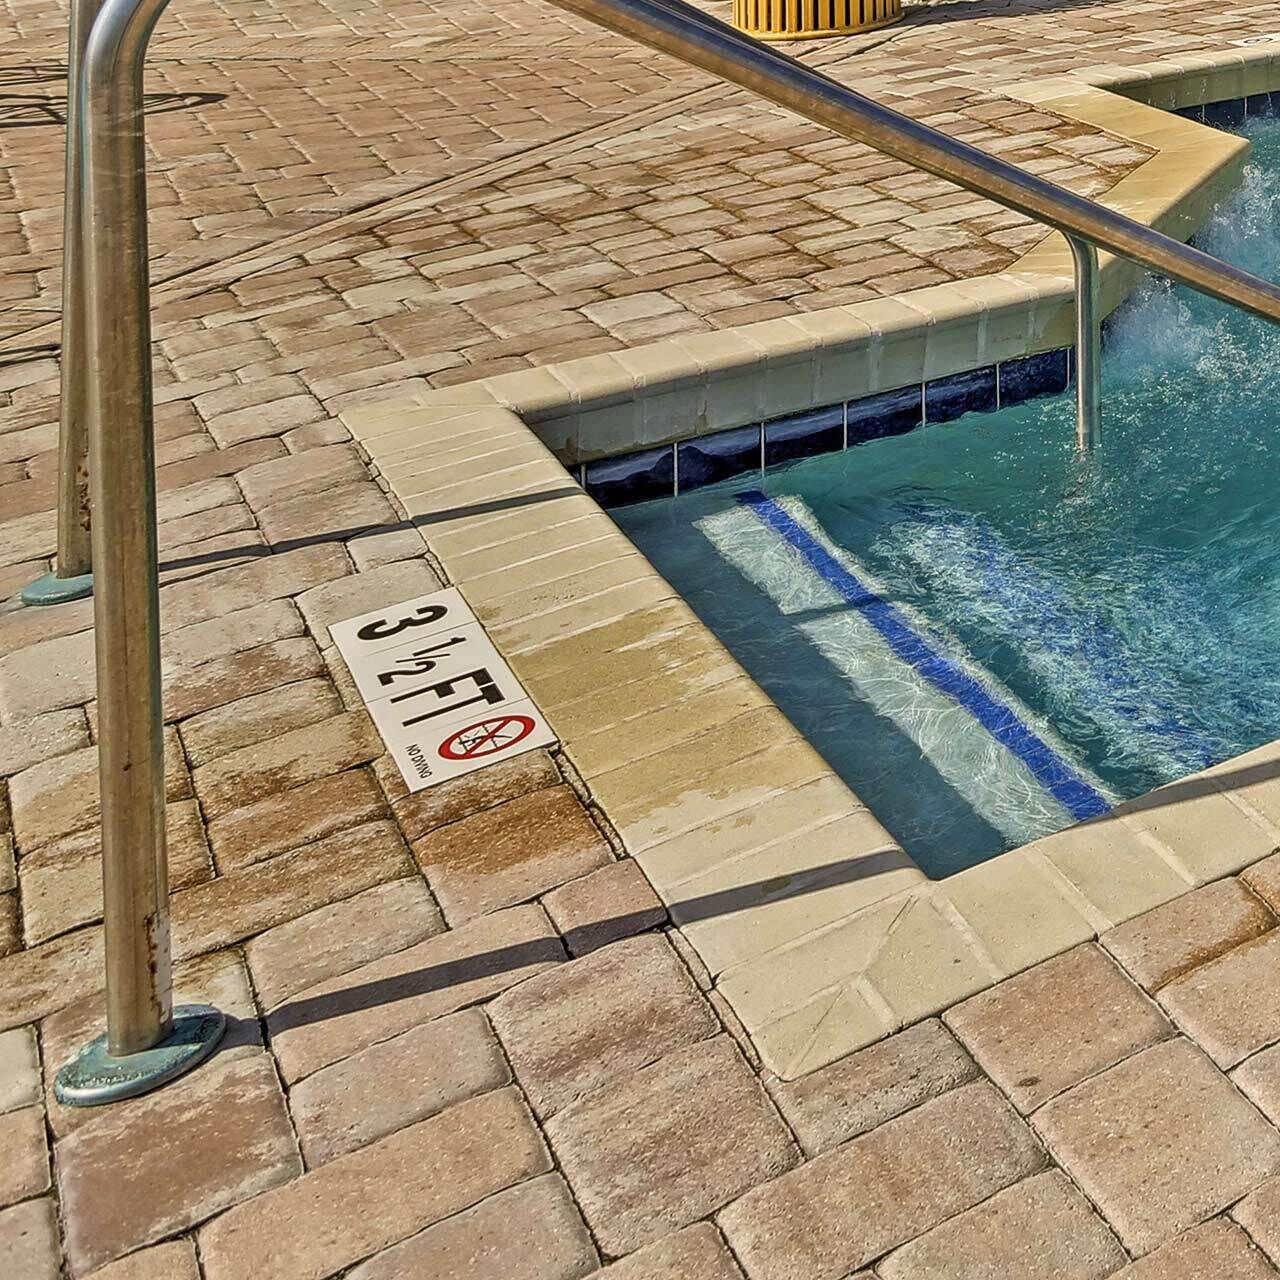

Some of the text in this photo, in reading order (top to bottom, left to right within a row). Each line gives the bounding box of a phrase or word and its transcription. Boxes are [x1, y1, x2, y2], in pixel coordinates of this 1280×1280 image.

[357, 605, 448, 641] 3
[390, 667, 506, 727] FT
[405, 743, 433, 779] NO DIVING
